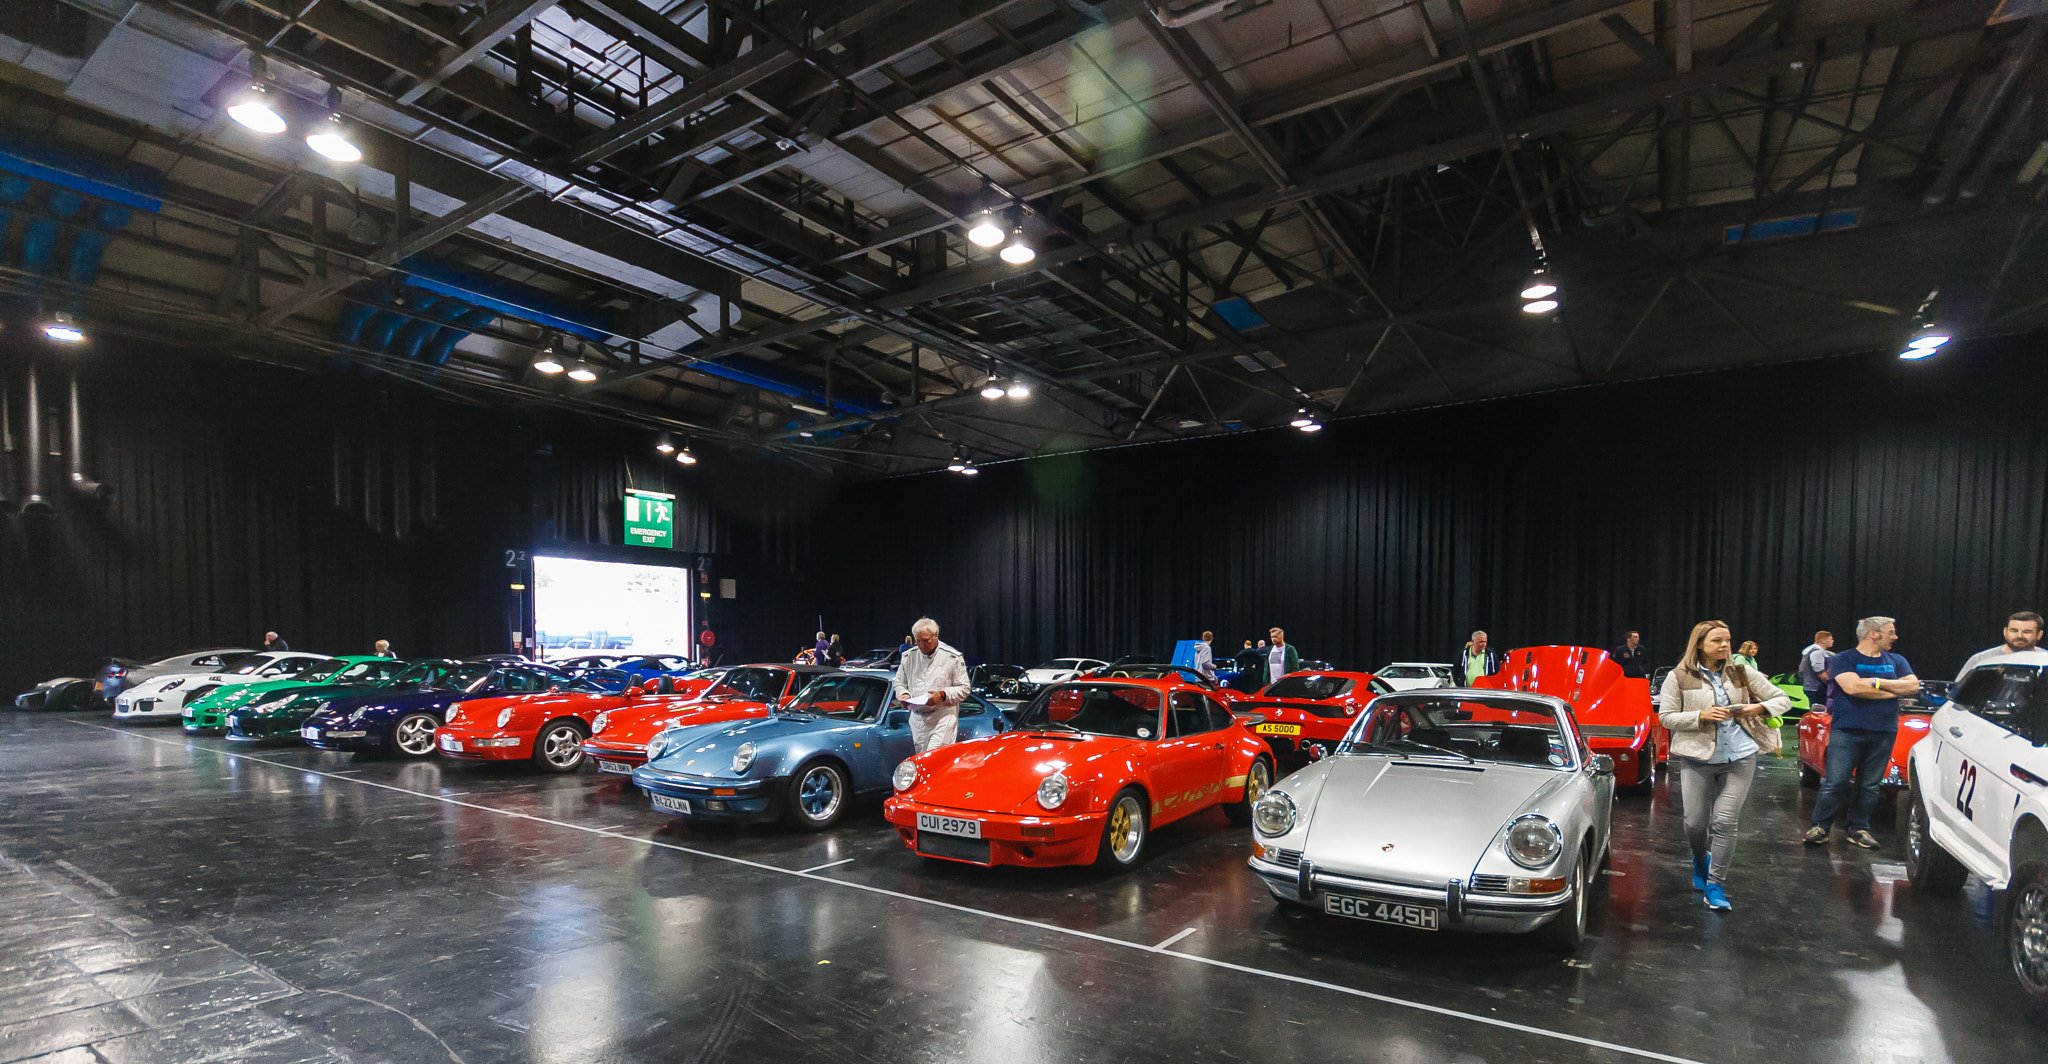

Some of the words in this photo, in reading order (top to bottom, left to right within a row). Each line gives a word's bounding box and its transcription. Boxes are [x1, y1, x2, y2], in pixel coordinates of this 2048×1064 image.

[630, 527, 667, 537] EMERGENCY
[1262, 724, 1272, 732] AS
[1274, 724, 1295, 733] 5000
[1956, 759, 1977, 822] 22
[921, 815, 940, 829] CUI
[942, 819, 976, 834] 2979
[1326, 895, 1369, 917] EGC
[1375, 903, 1436, 928] 445H
